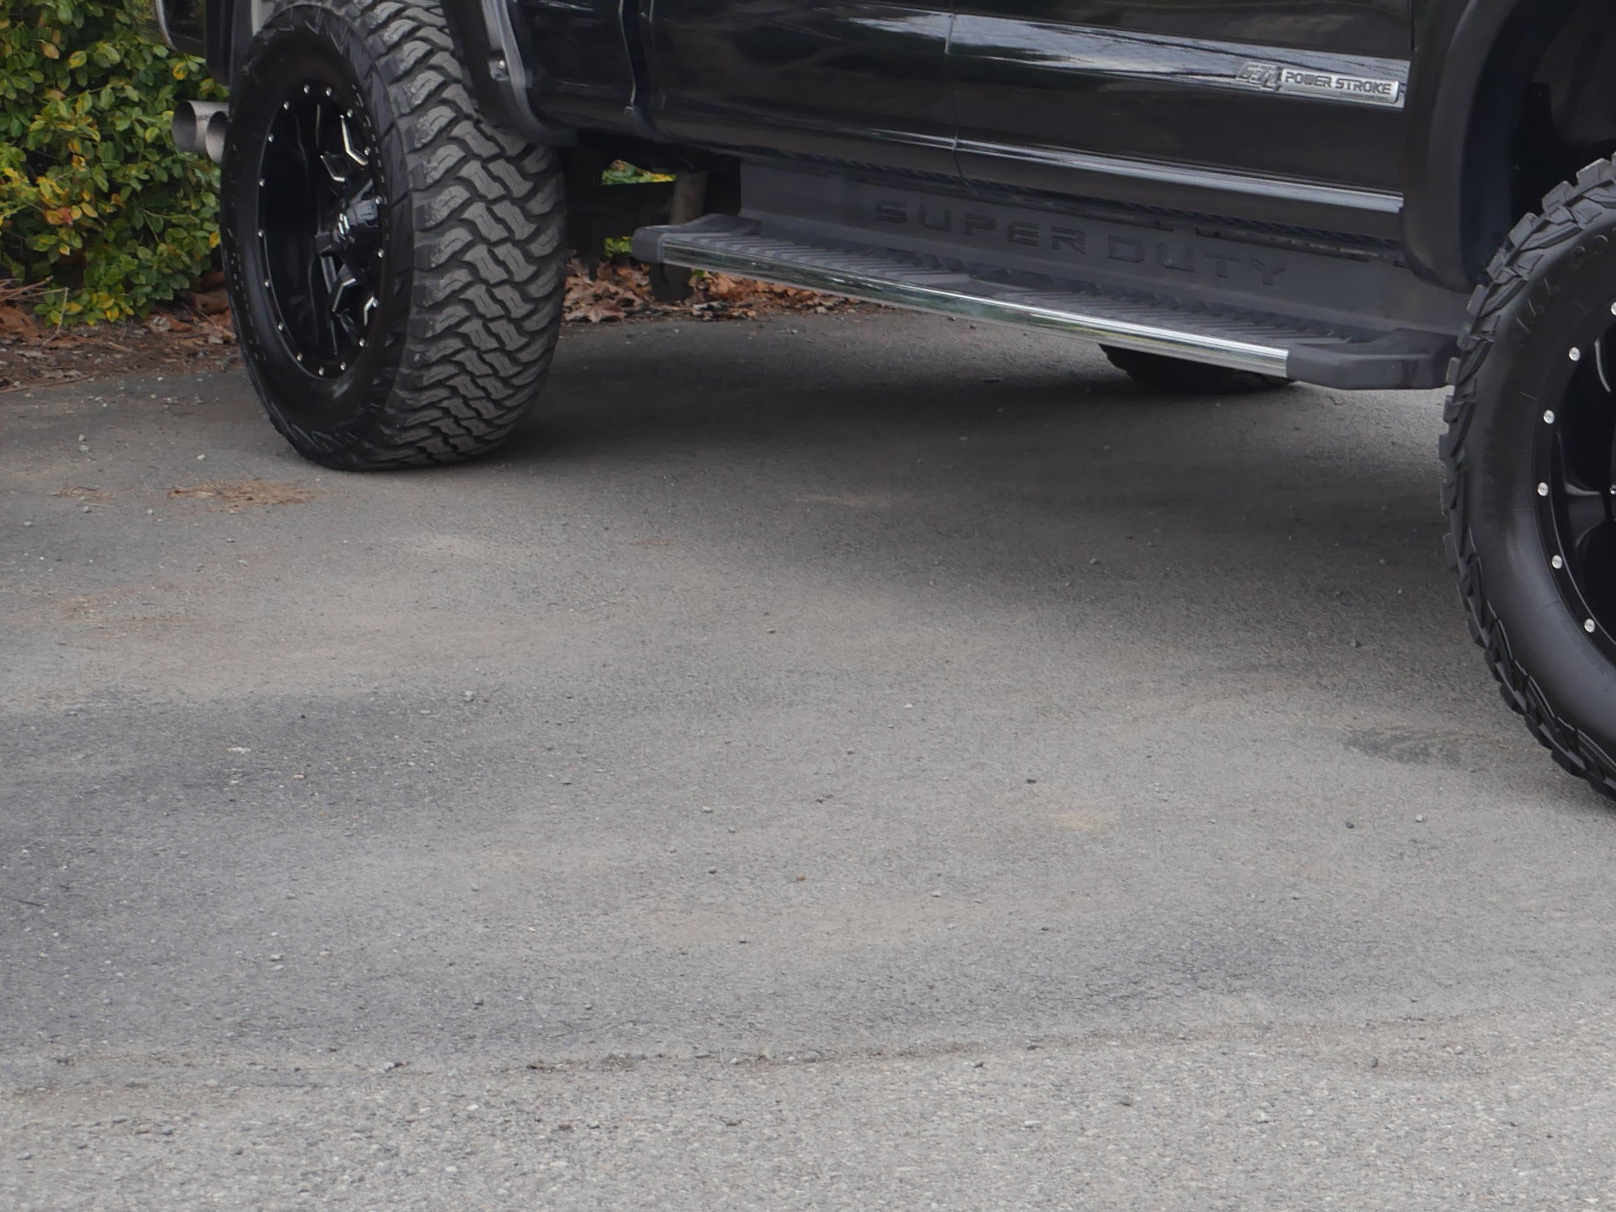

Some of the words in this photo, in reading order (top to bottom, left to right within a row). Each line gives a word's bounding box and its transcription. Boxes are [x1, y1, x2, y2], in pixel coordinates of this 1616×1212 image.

[1284, 71, 1332, 88] POWER
[1335, 77, 1392, 95] STROKE
[874, 198, 1087, 255] SUPER
[1108, 231, 1288, 287] DUTY
